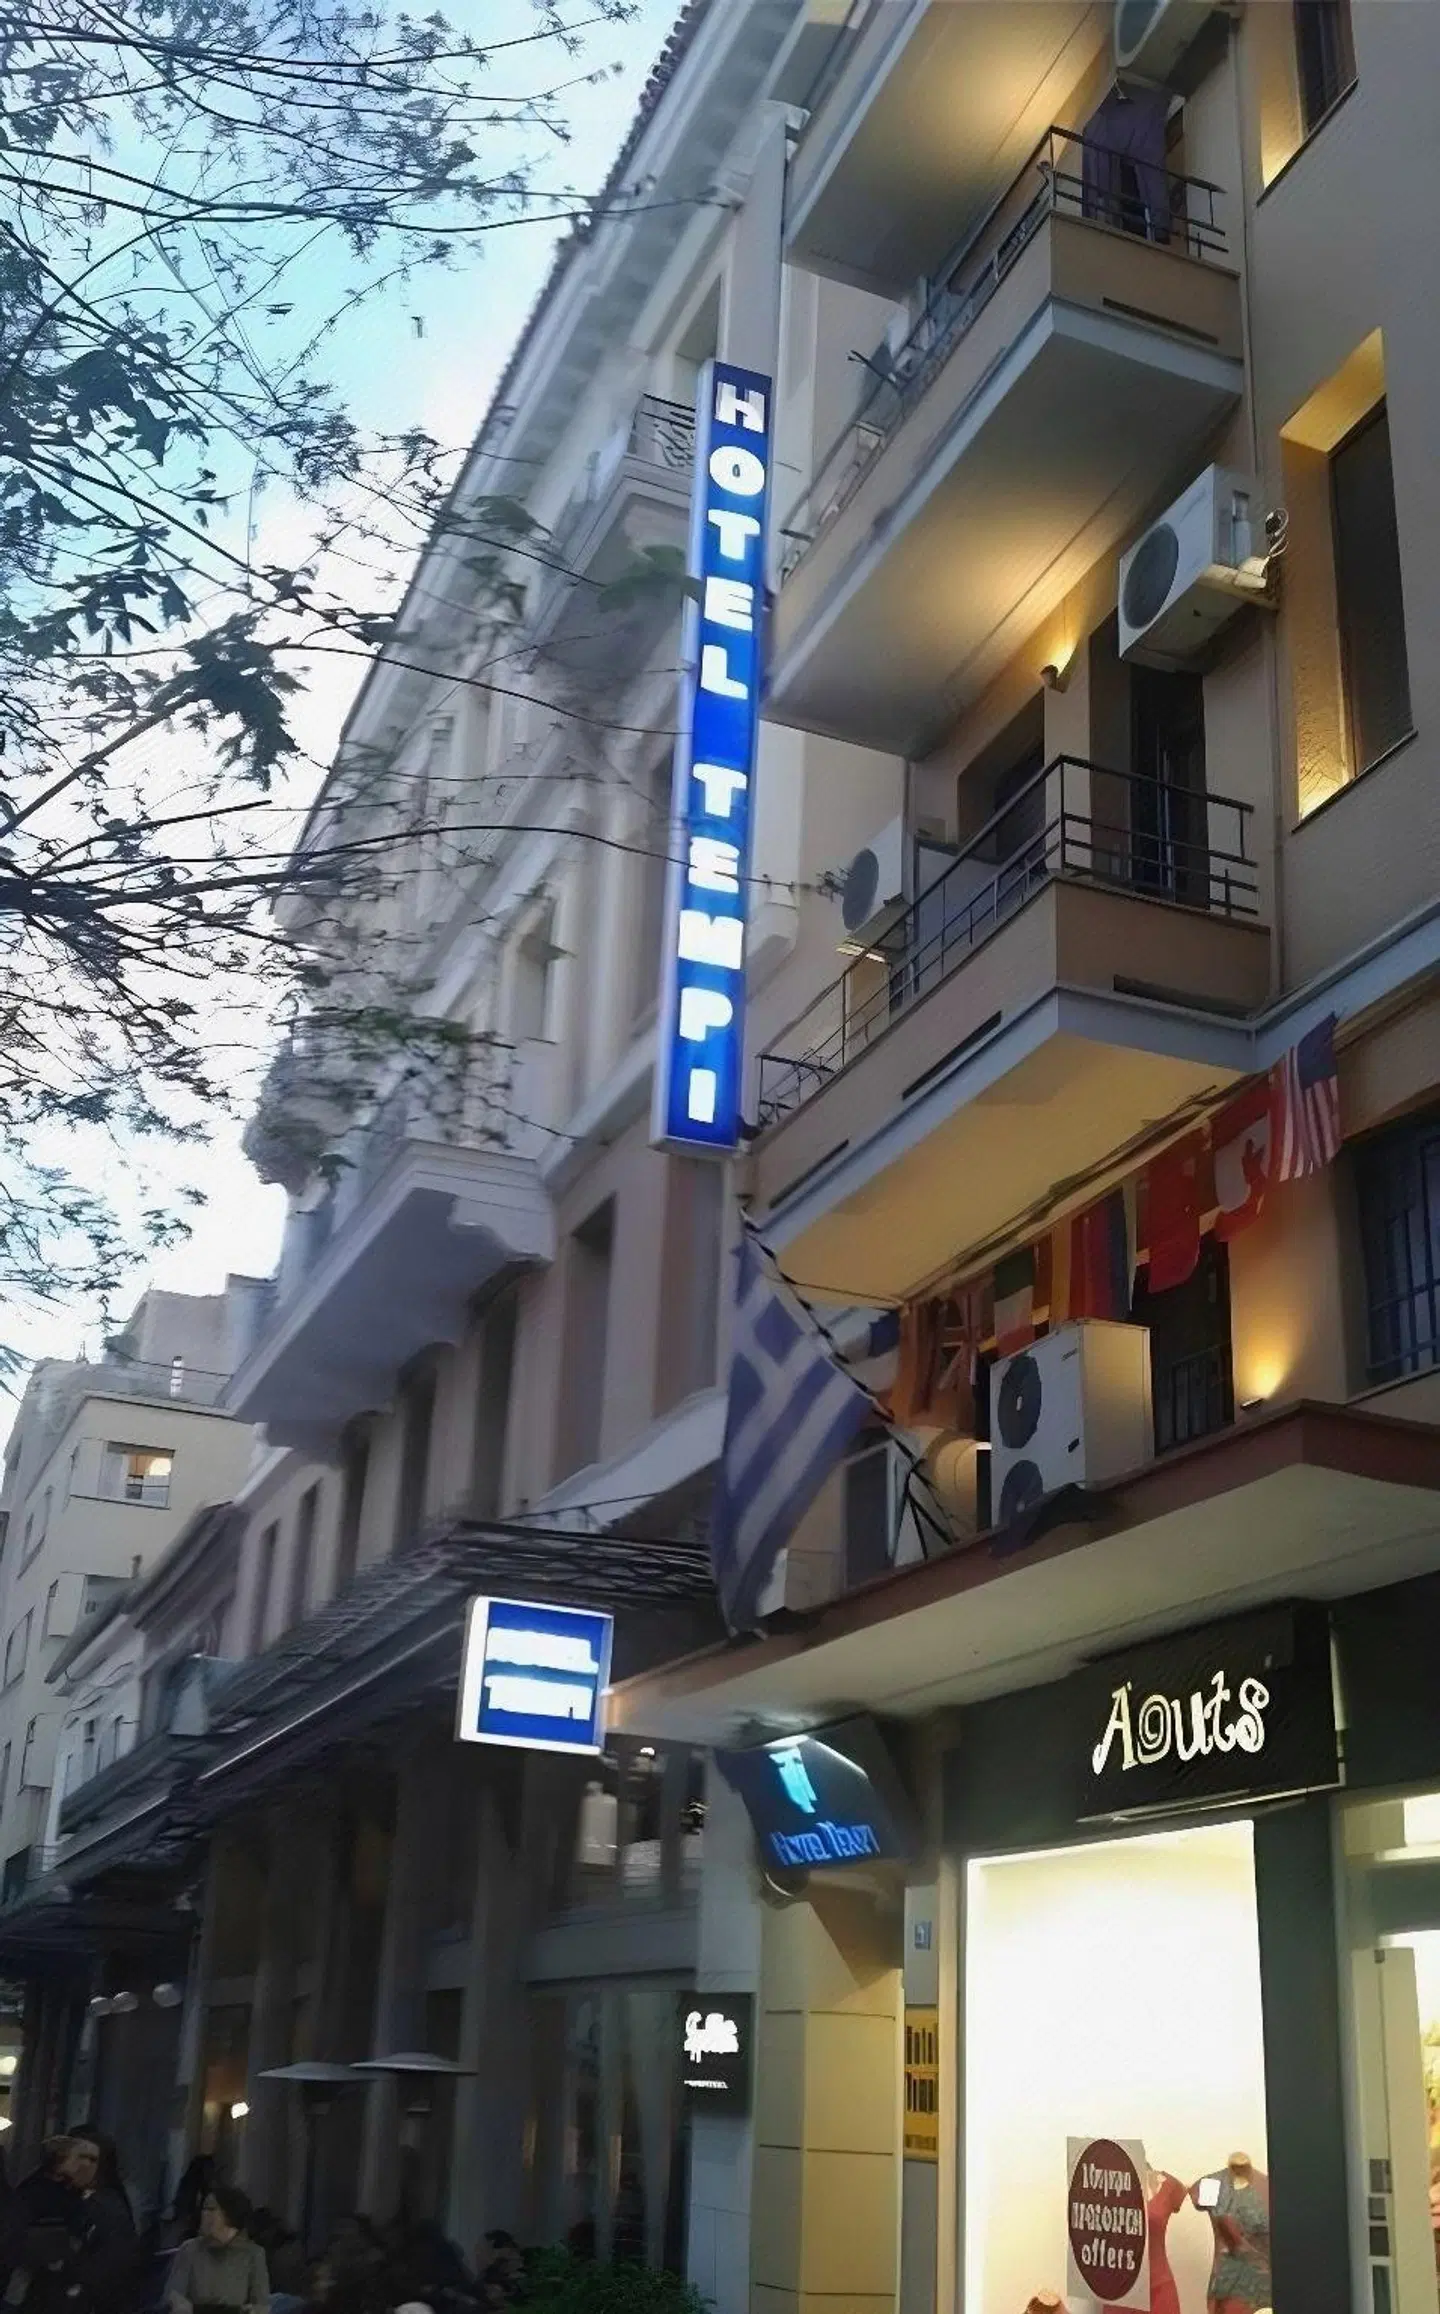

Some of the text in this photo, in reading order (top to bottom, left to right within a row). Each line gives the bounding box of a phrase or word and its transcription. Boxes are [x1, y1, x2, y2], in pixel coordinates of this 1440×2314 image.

[678, 381, 766, 1124] HOTEL TEMPI
[1081, 2238, 1136, 2271] offers
